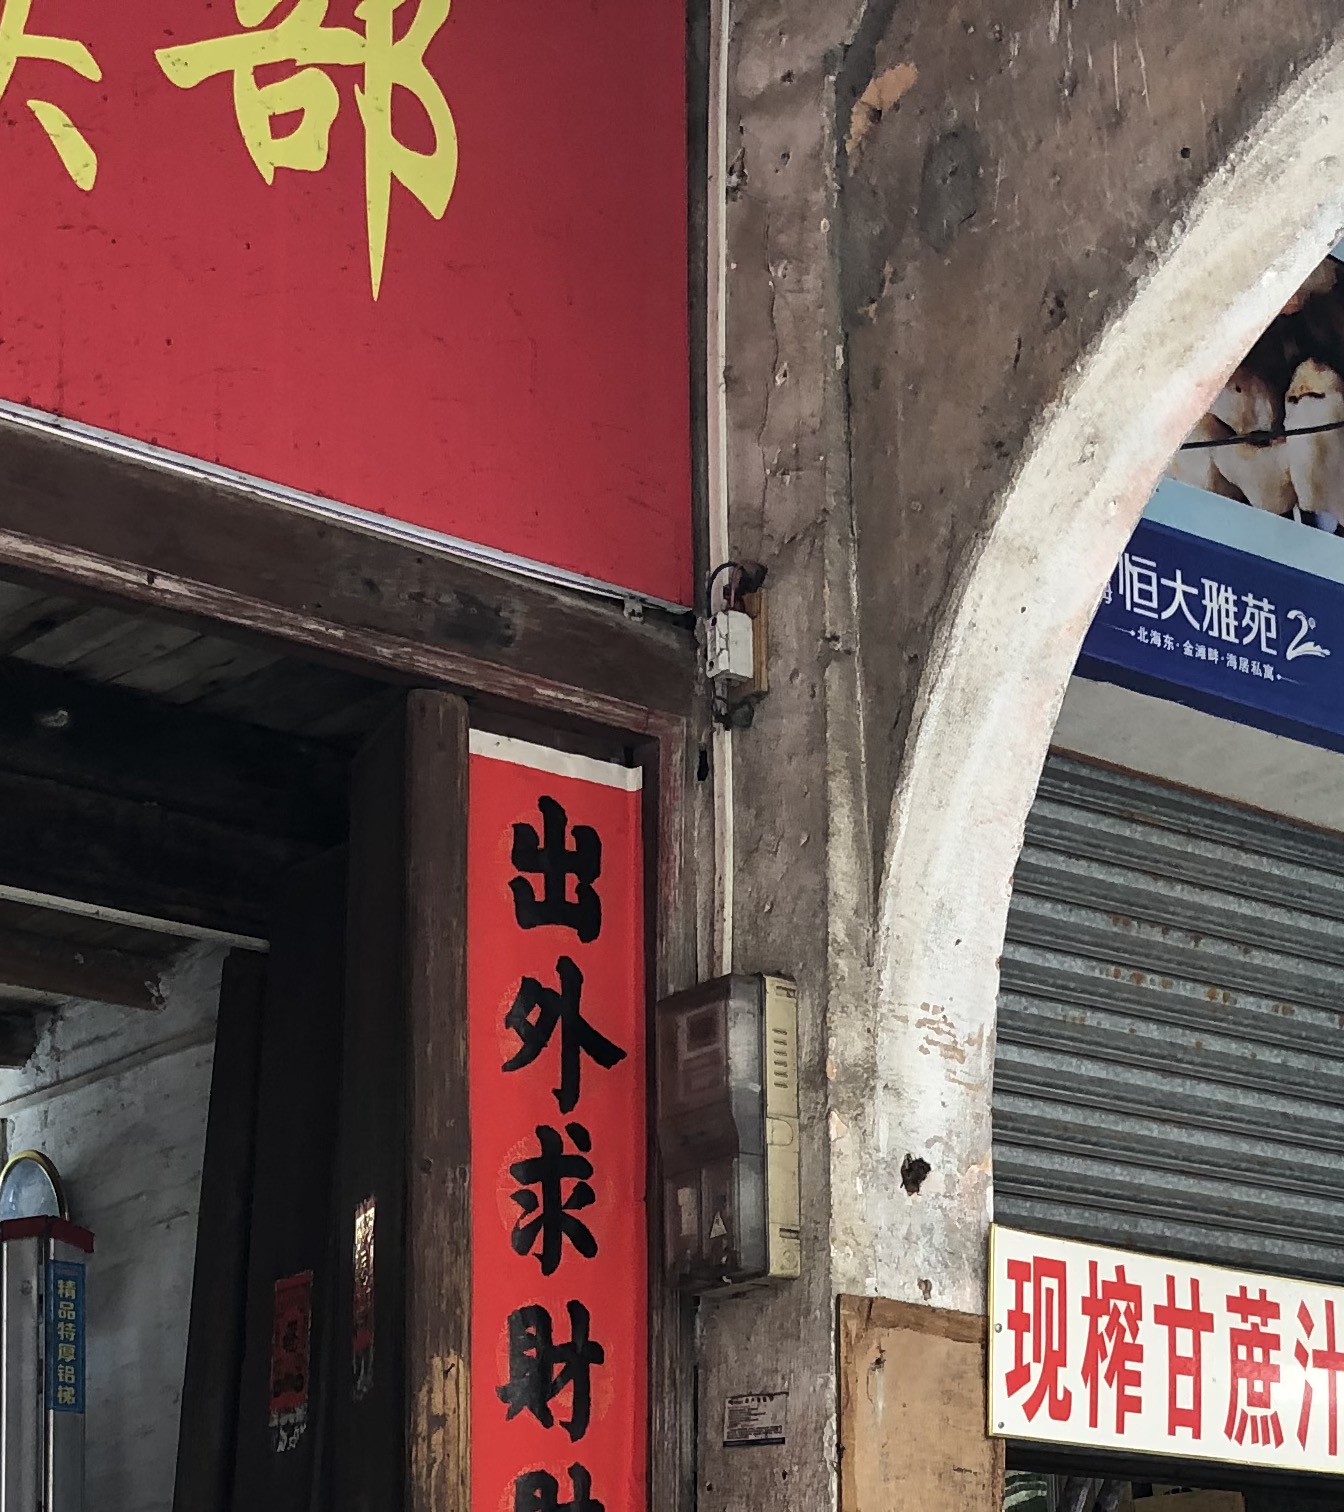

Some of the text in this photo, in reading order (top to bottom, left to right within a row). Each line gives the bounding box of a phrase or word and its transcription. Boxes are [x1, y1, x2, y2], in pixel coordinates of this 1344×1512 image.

[57, 1279, 76, 1406] 精品特厚铝梯
